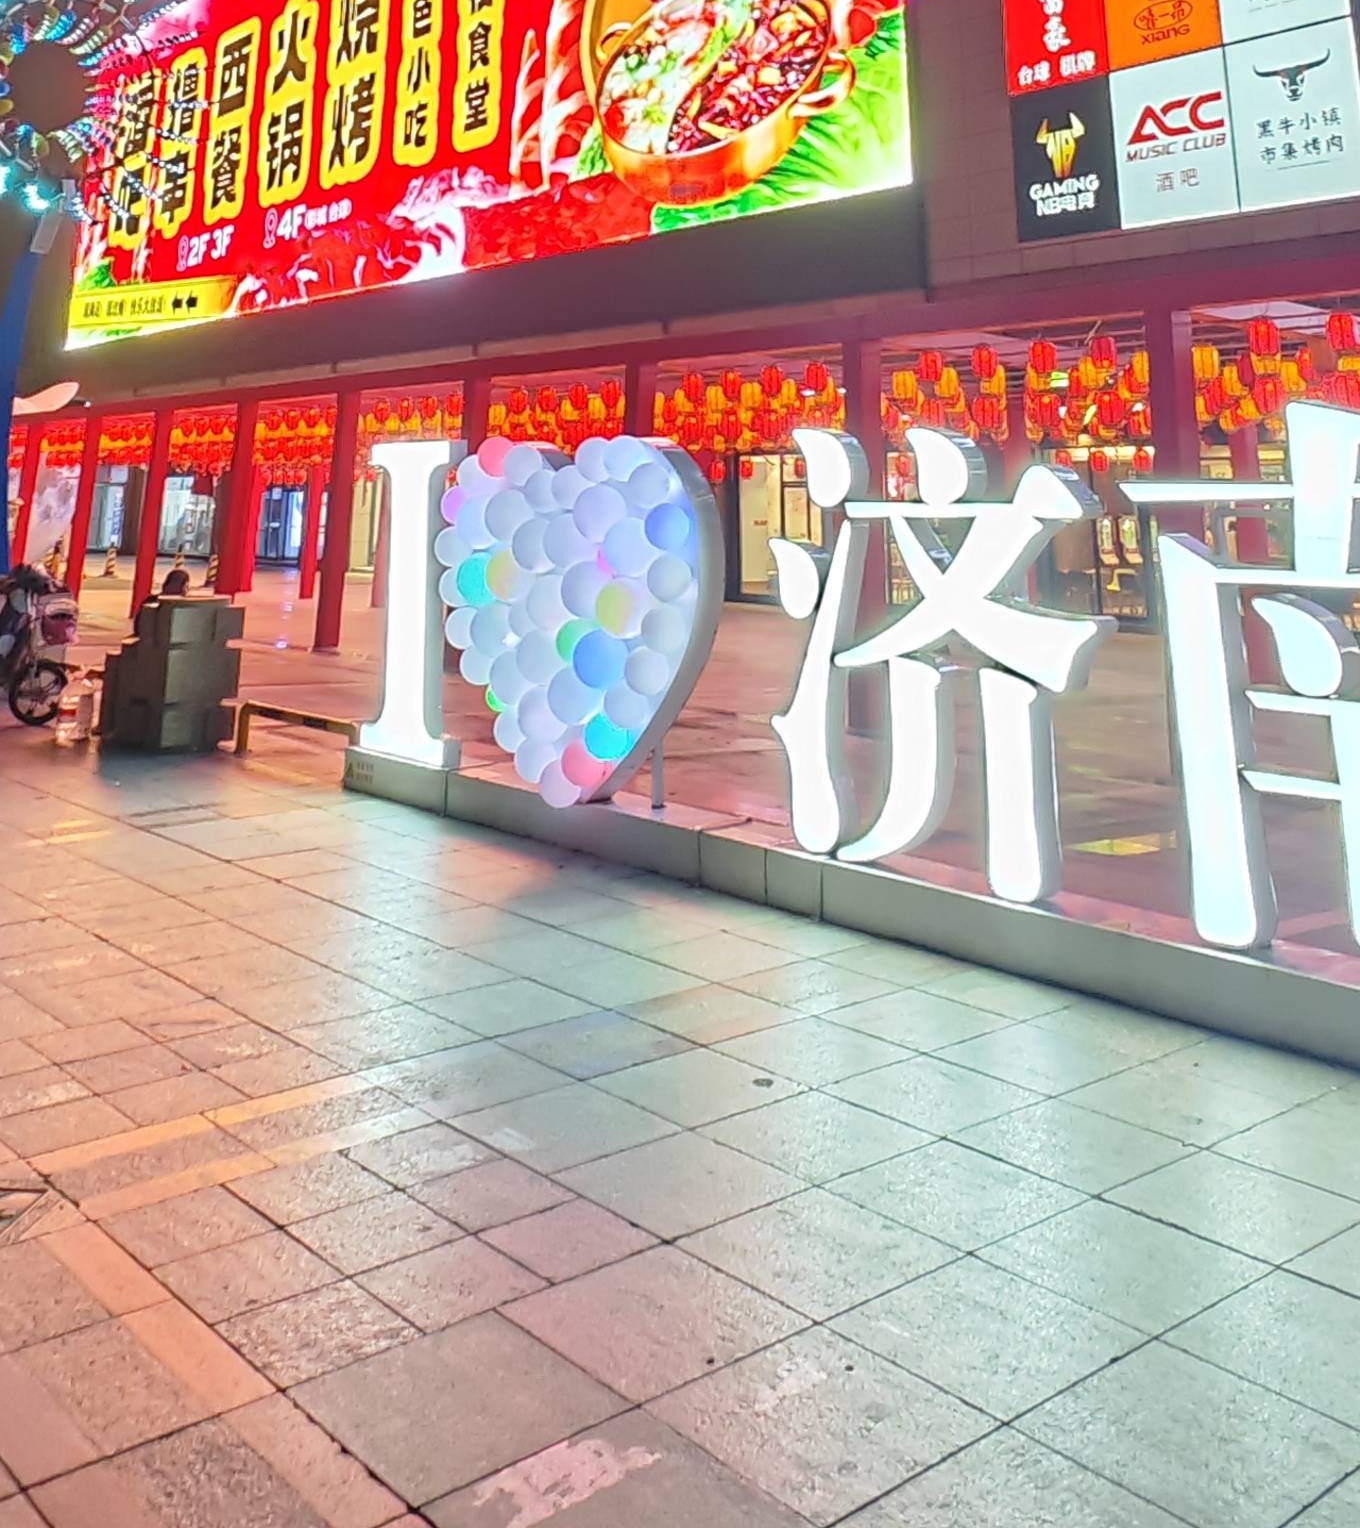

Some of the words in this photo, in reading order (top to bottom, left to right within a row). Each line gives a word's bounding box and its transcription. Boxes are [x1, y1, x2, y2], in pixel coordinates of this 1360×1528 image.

[265, 9, 312, 193] 火锅
[1126, 90, 1226, 147] ACC
[211, 32, 255, 210] 西餐
[1256, 106, 1342, 140] 黑牛小镇
[1124, 140, 1179, 163] MUSIC
[1182, 132, 1228, 153] CLUB
[1259, 133, 1345, 166] 市集烤肉
[1028, 173, 1101, 202] GAMING
[1155, 167, 1201, 193] 酒吧
[276, 204, 308, 241] 4F
[187, 232, 211, 268] 2F
[210, 224, 235, 260] 3F
